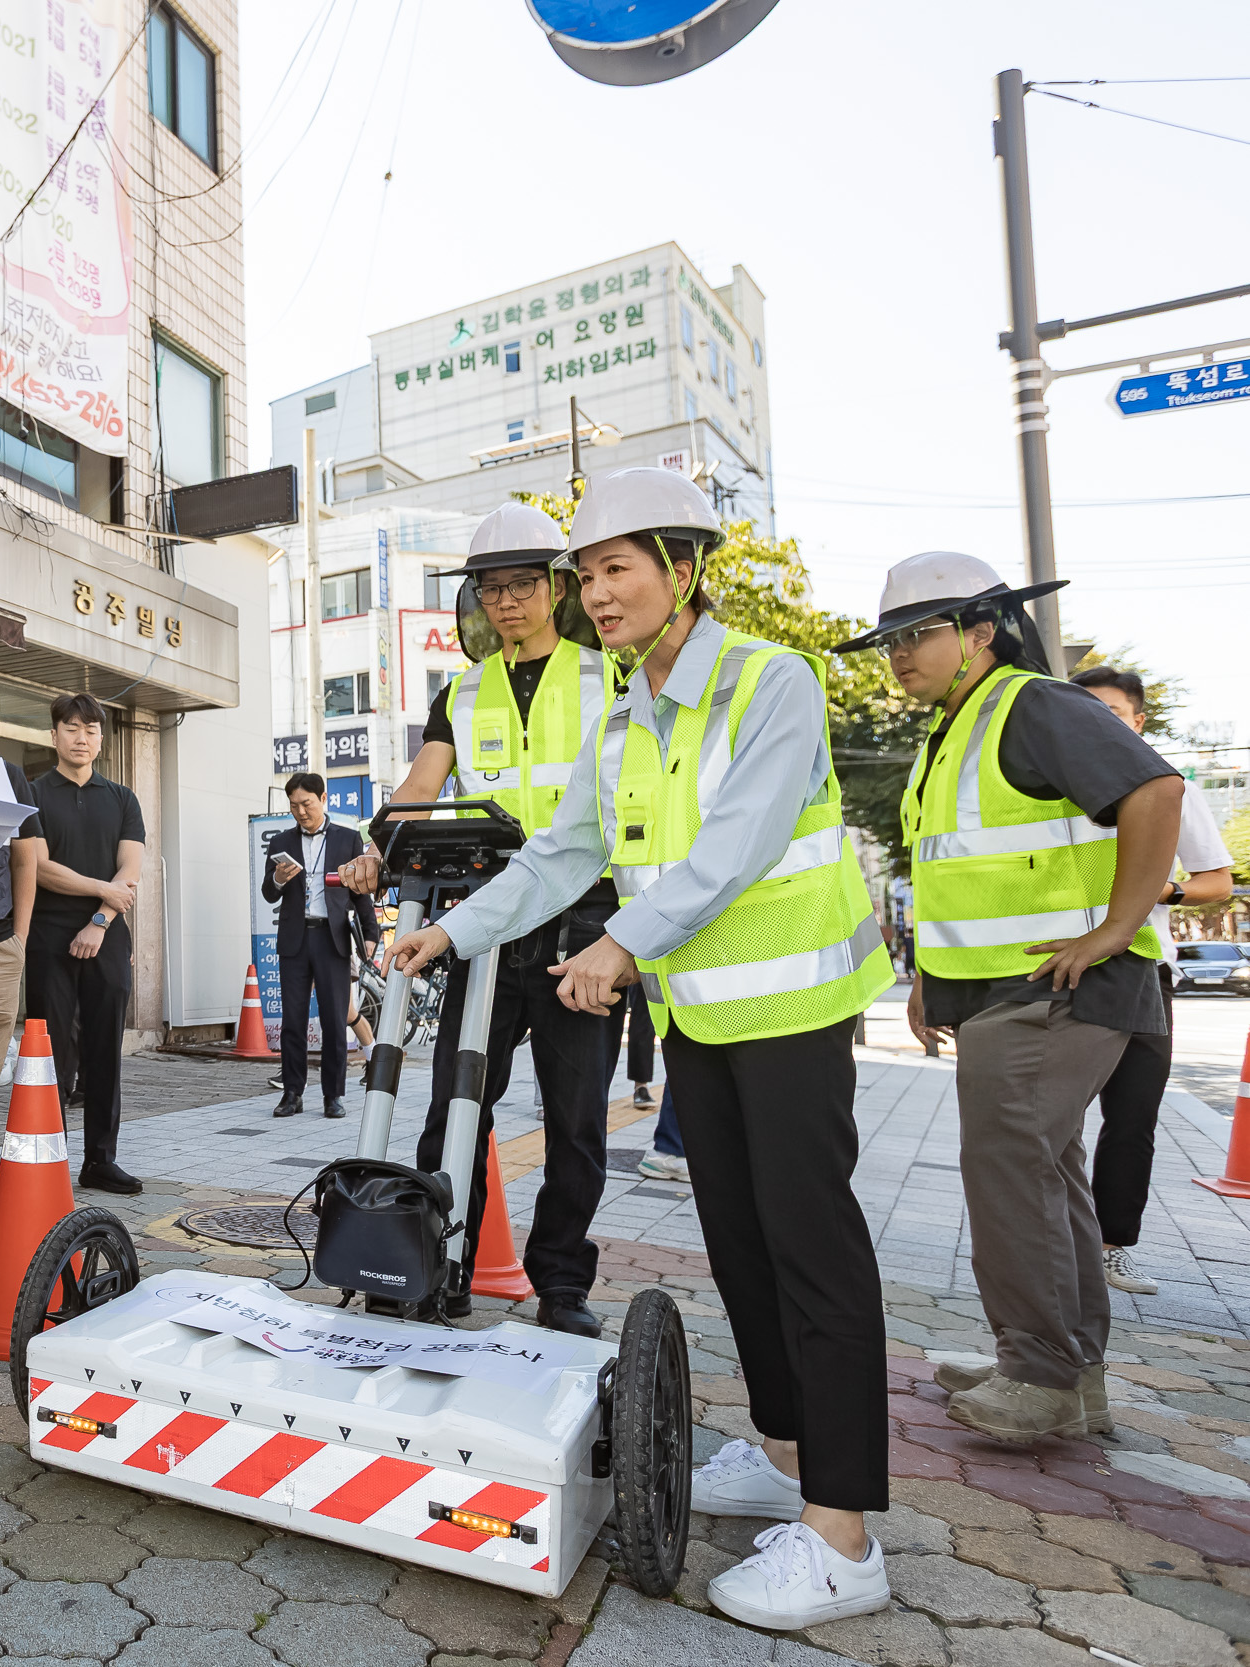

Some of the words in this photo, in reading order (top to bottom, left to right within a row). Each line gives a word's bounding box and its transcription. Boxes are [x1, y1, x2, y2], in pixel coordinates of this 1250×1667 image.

[482, 301, 547, 334] 김학윤
[556, 265, 653, 311] 정형외과
[544, 338, 658, 384] 치하임치과
[1165, 363, 1249, 392] 뚝섬로
[359, 1269, 407, 1283] ROCKBROS
[186, 1292, 292, 1330] 지반침하
[299, 1329, 413, 1352] 특별점검
[420, 1342, 544, 1363] 공동조사
